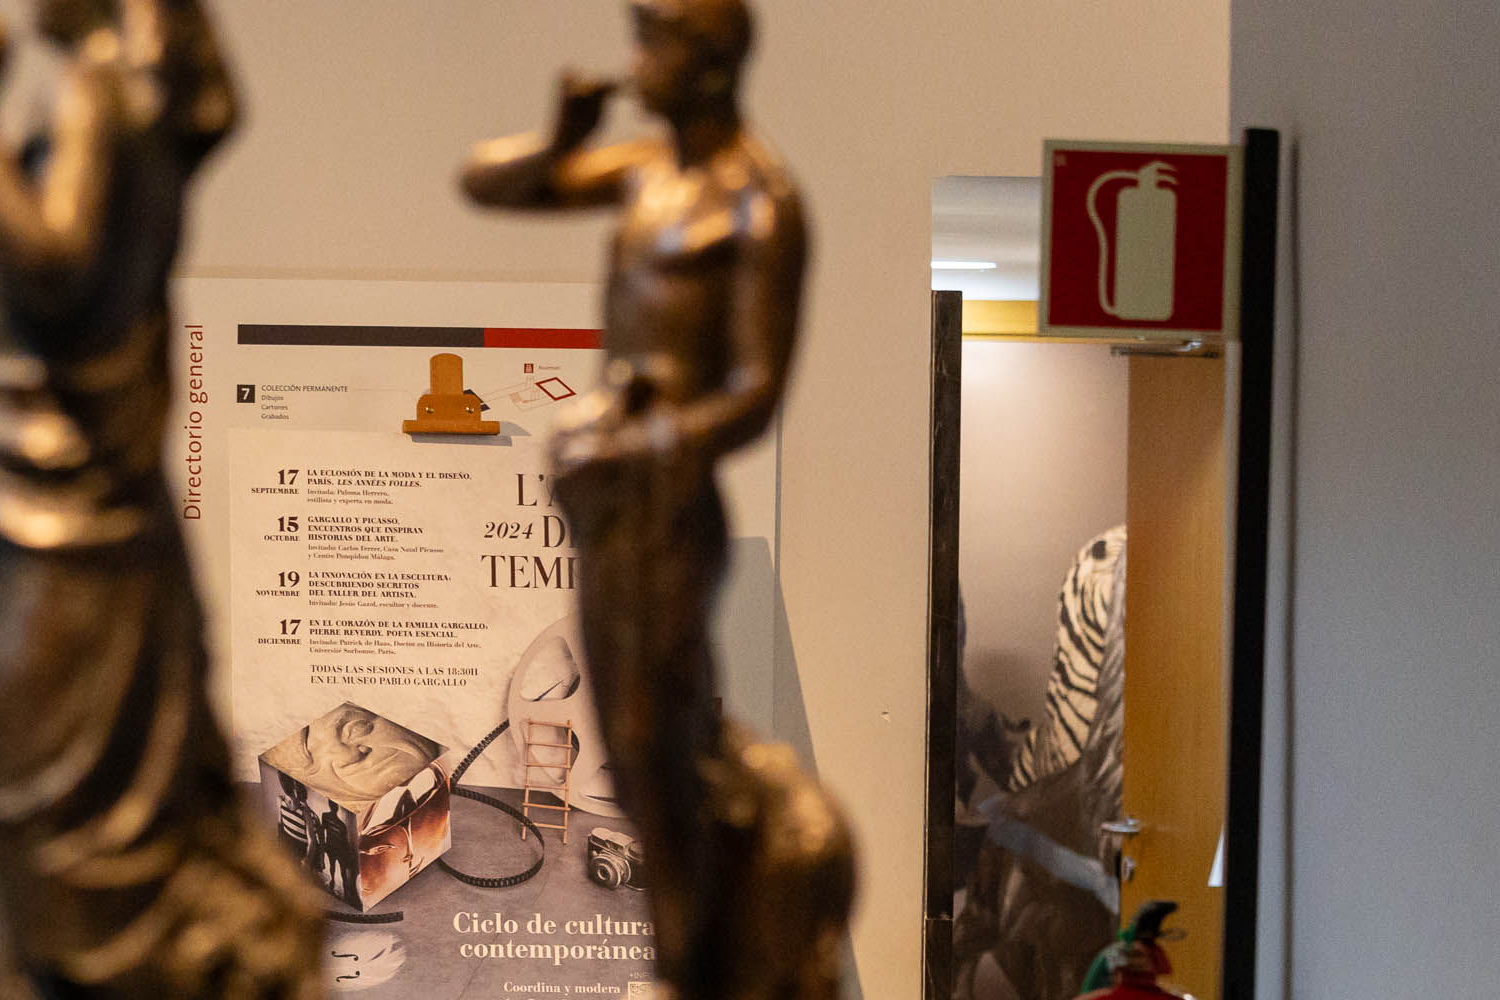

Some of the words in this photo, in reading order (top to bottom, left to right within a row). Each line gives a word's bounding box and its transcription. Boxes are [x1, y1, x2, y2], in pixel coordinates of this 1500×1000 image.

[184, 324, 208, 405] general
[241, 388, 251, 401] 7
[261, 384, 301, 392] COLECCIÓN
[302, 385, 349, 393] PERMANENTE
[261, 394, 284, 402] Dibujos
[183, 411, 203, 520] Directorio
[277, 469, 300, 485] 17
[320, 468, 362, 478] ECLOSIÓN
[364, 471, 377, 479] DE
[378, 471, 389, 479] LA
[392, 471, 416, 479] MODA
[418, 472, 424, 480] Y
[426, 472, 437, 480] EL
[336, 479, 353, 487] LES
[251, 487, 300, 495] SEPTIEMBRE
[277, 515, 300, 533] 15
[308, 516, 352, 524] GARGALLO
[308, 525, 362, 533] ENCUENTROS
[364, 526, 381, 534] QUE
[384, 527, 424, 535] INSPIRAN
[484, 521, 533, 540] 2024
[263, 534, 300, 542] OCTUBRE
[308, 534, 353, 542] HISTORIAS
[278, 570, 300, 588] 19
[308, 571, 319, 579] LA
[322, 570, 372, 580] INNOVACIÓN
[374, 573, 386, 581] EN
[388, 573, 399, 581] LA
[308, 580, 374, 589] DESCUBRIENDO
[376, 582, 420, 590] SECRETOS
[256, 589, 300, 597] NOVIEMBRE
[308, 589, 324, 597] DEL
[328, 590, 359, 598] TALLER
[362, 590, 379, 598] DEL
[406, 603, 411, 611] y
[279, 618, 301, 636] 17
[322, 620, 334, 628] EL
[336, 618, 376, 629] CORAZÓN
[378, 621, 390, 629] DE
[392, 621, 403, 629] LA
[406, 622, 439, 630] FAMILIA
[308, 628, 341, 637] PIERRE
[386, 630, 413, 638] POETA
[257, 637, 301, 645] DICIEMBRE
[310, 665, 344, 675] TODAS
[346, 666, 364, 675] LAS
[366, 666, 415, 676] SESIONES
[418, 667, 424, 676] A
[426, 667, 445, 677] LAS
[310, 676, 325, 685] EN
[326, 676, 340, 685] EL
[342, 677, 378, 686] MUSEO
[380, 677, 412, 687] PABLO
[414, 678, 468, 688] GARGALLO
[453, 911, 518, 934] Ciclo
[526, 912, 557, 935] de
[565, 914, 655, 936] cultura
[460, 938, 655, 966] contemporánea
[503, 981, 561, 993] Coordina
[564, 985, 571, 996] y
[575, 983, 621, 994] modera
